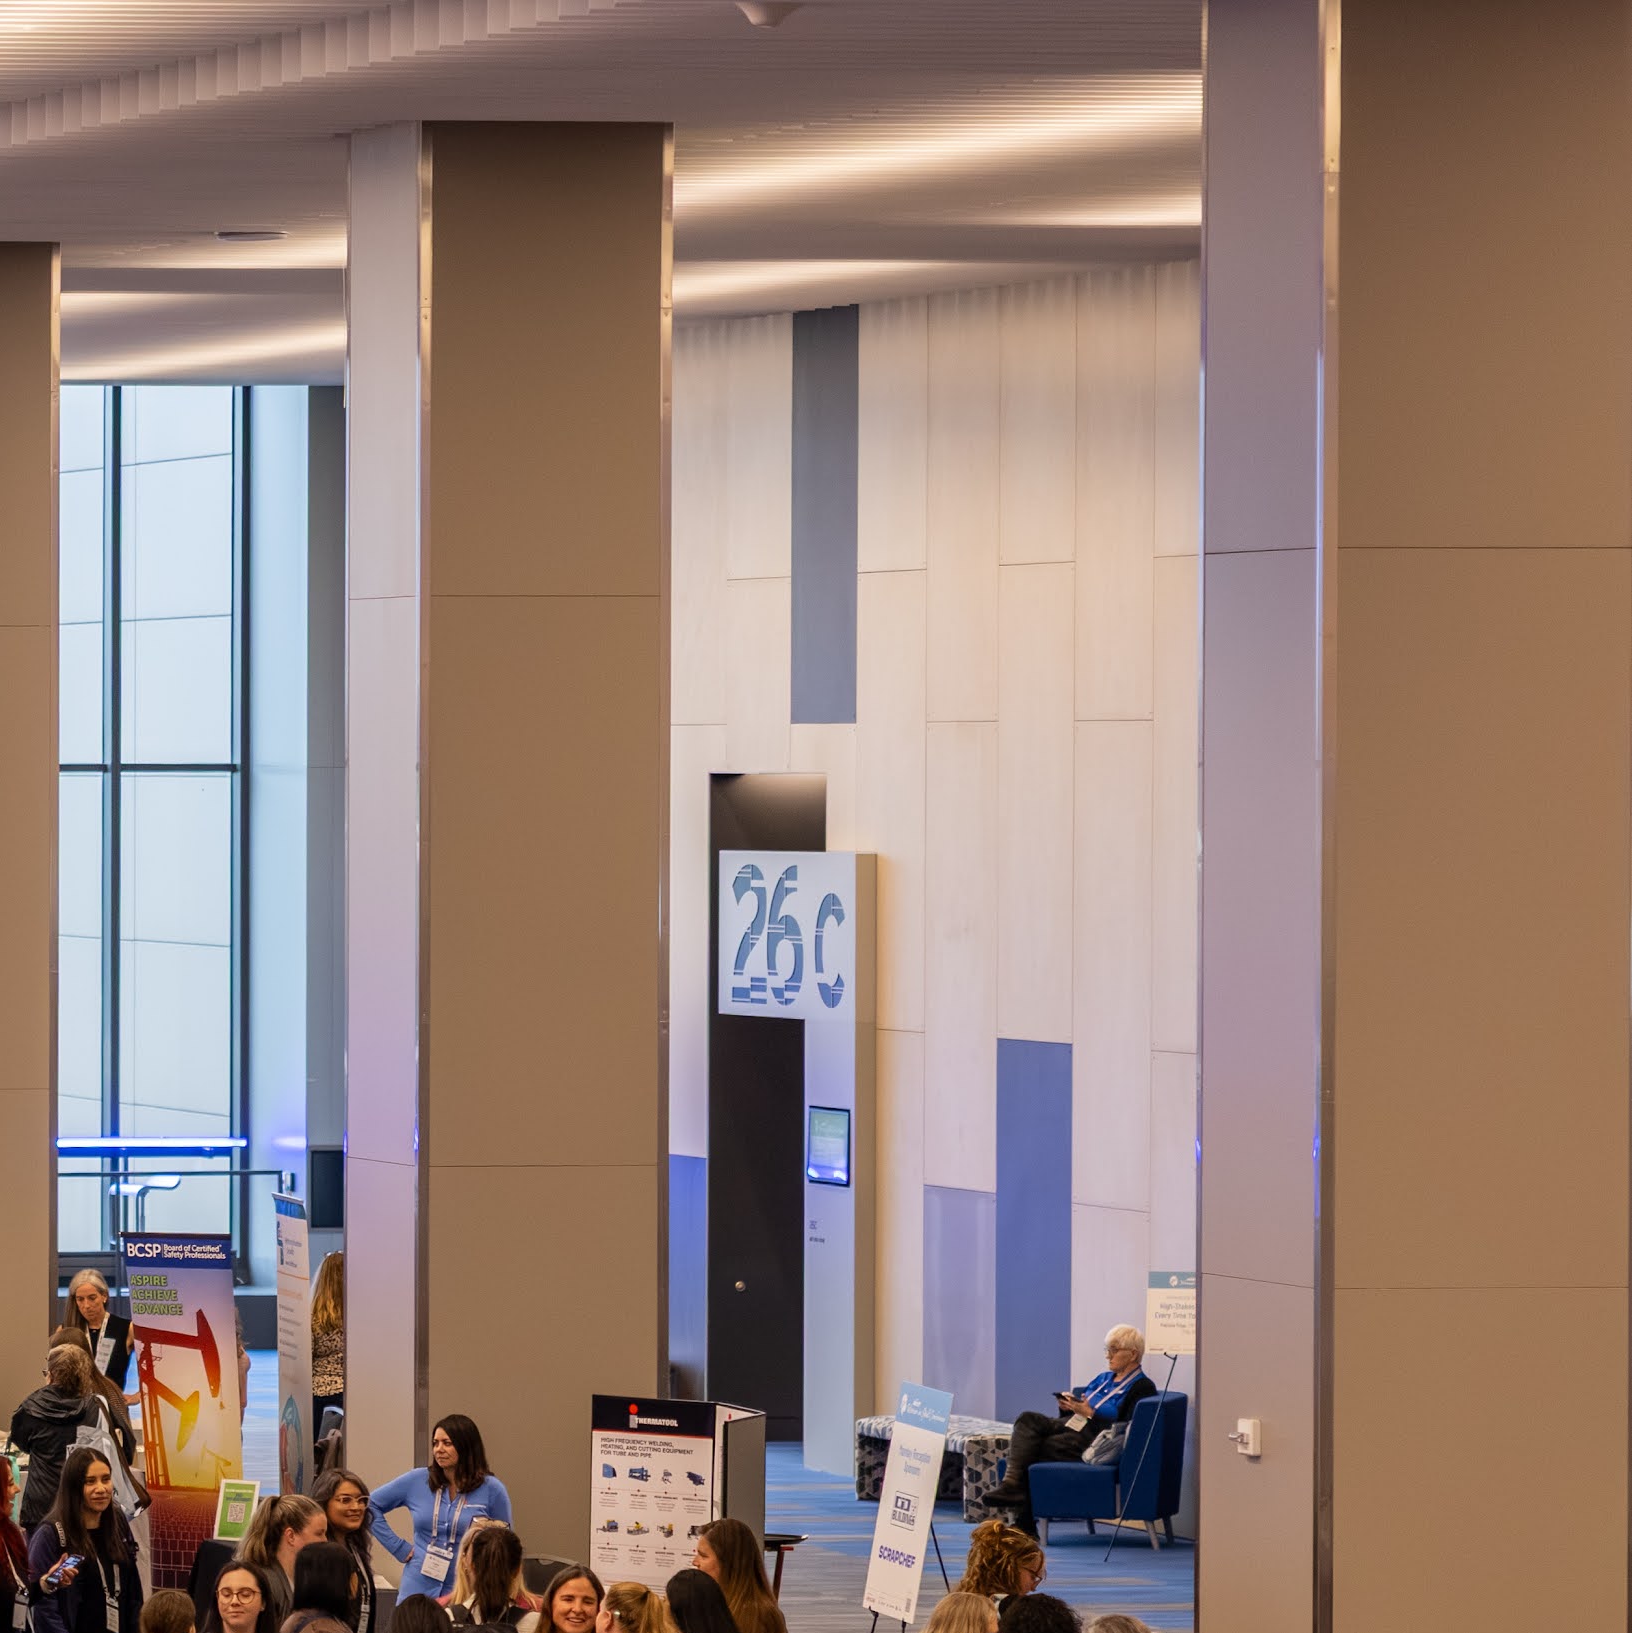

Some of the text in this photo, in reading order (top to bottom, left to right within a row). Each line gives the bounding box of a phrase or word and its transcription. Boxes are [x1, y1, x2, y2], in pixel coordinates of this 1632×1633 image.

[731, 863, 846, 1009] 26 C
[127, 1242, 162, 1257] BCSP
[163, 1243, 182, 1251] Board
[191, 1244, 220, 1252] Certified
[163, 1251, 226, 1260] Safety Professionals
[130, 1275, 167, 1286] ASPIRE
[132, 1289, 178, 1300] ACHIEVE
[132, 1303, 183, 1315] ADVANCE
[634, 1417, 679, 1427] THERMATOOL
[600, 1443, 625, 1451] HEATING,
[638, 1445, 661, 1453] CUTTING
[662, 1447, 694, 1455] EQUIPMENT
[615, 1438, 647, 1447] FREQUENCY
[648, 1440, 674, 1448] WELDING,
[891, 1509, 916, 1527] BUILDINGS
[878, 1544, 916, 1568] SCRAPCHEF
